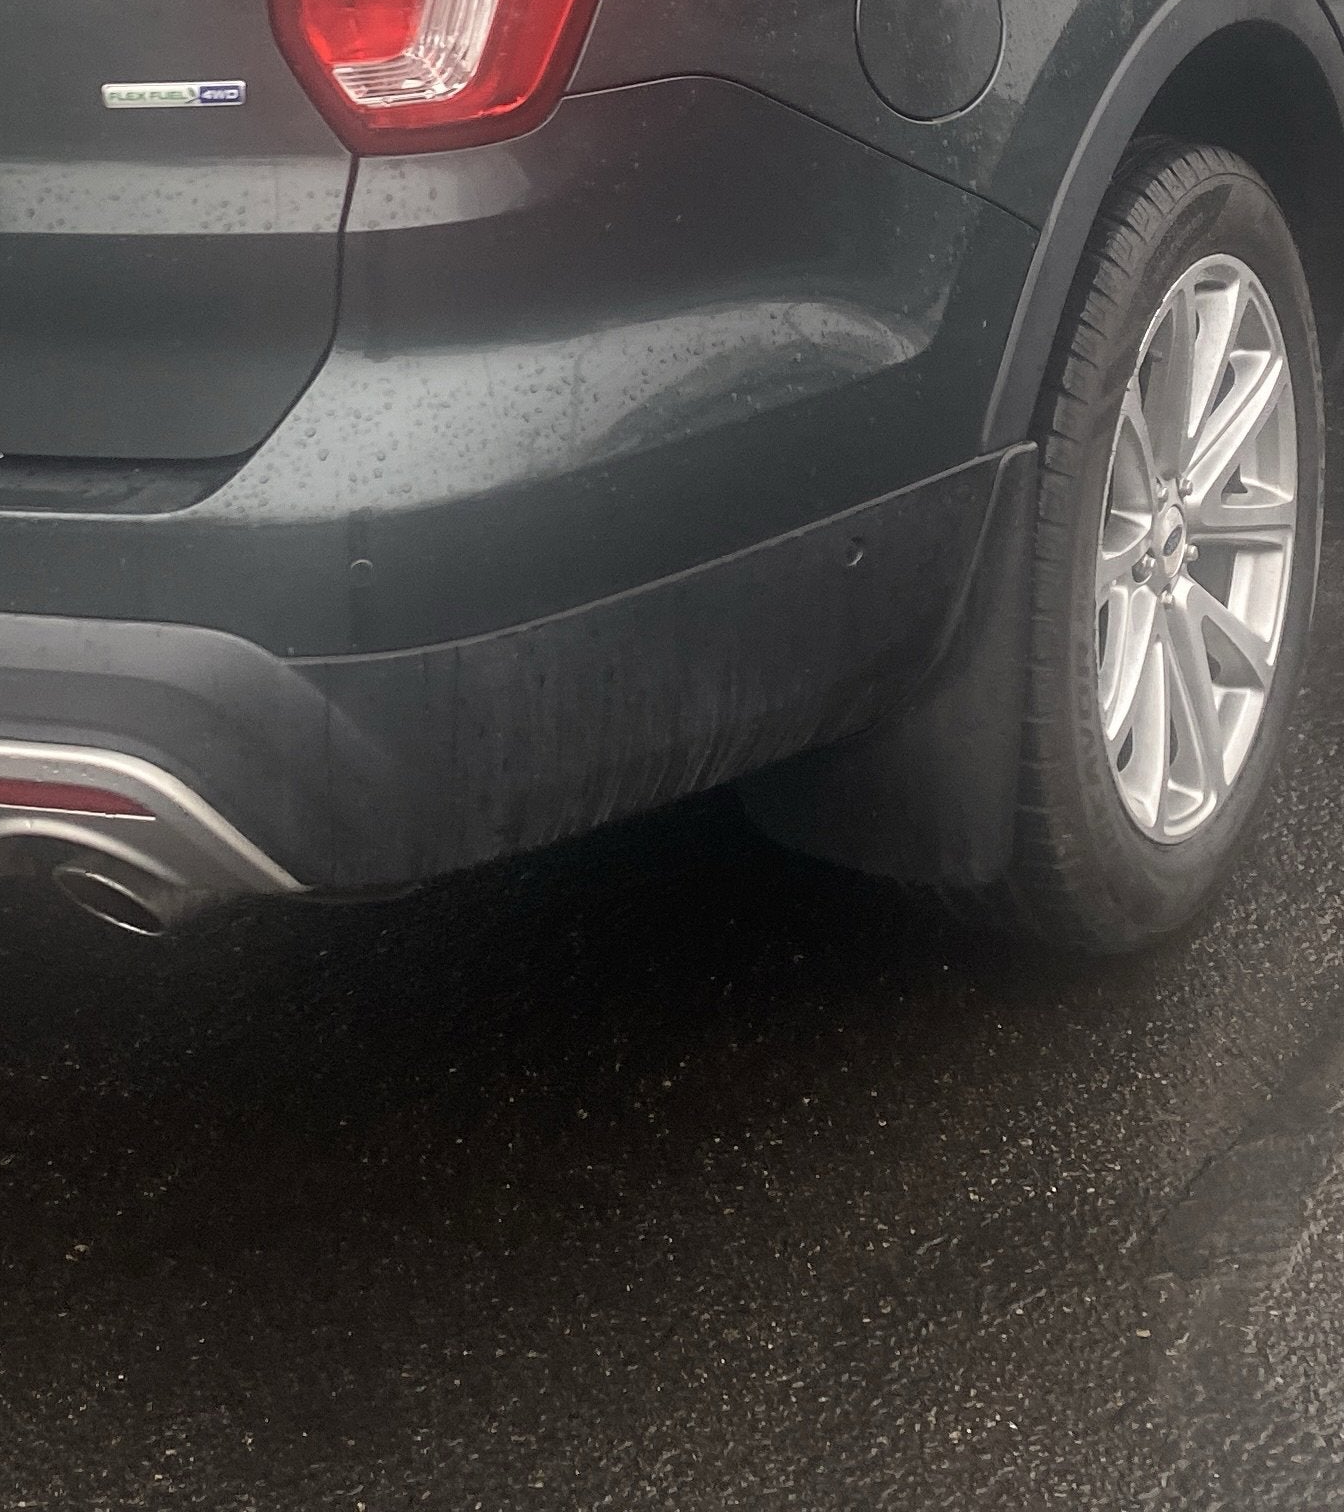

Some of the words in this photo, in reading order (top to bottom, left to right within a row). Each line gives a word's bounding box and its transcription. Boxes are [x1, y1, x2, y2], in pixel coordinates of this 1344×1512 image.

[109, 91, 147, 101] FLEX
[150, 91, 186, 101] FUEL
[201, 89, 240, 100] 4WD
